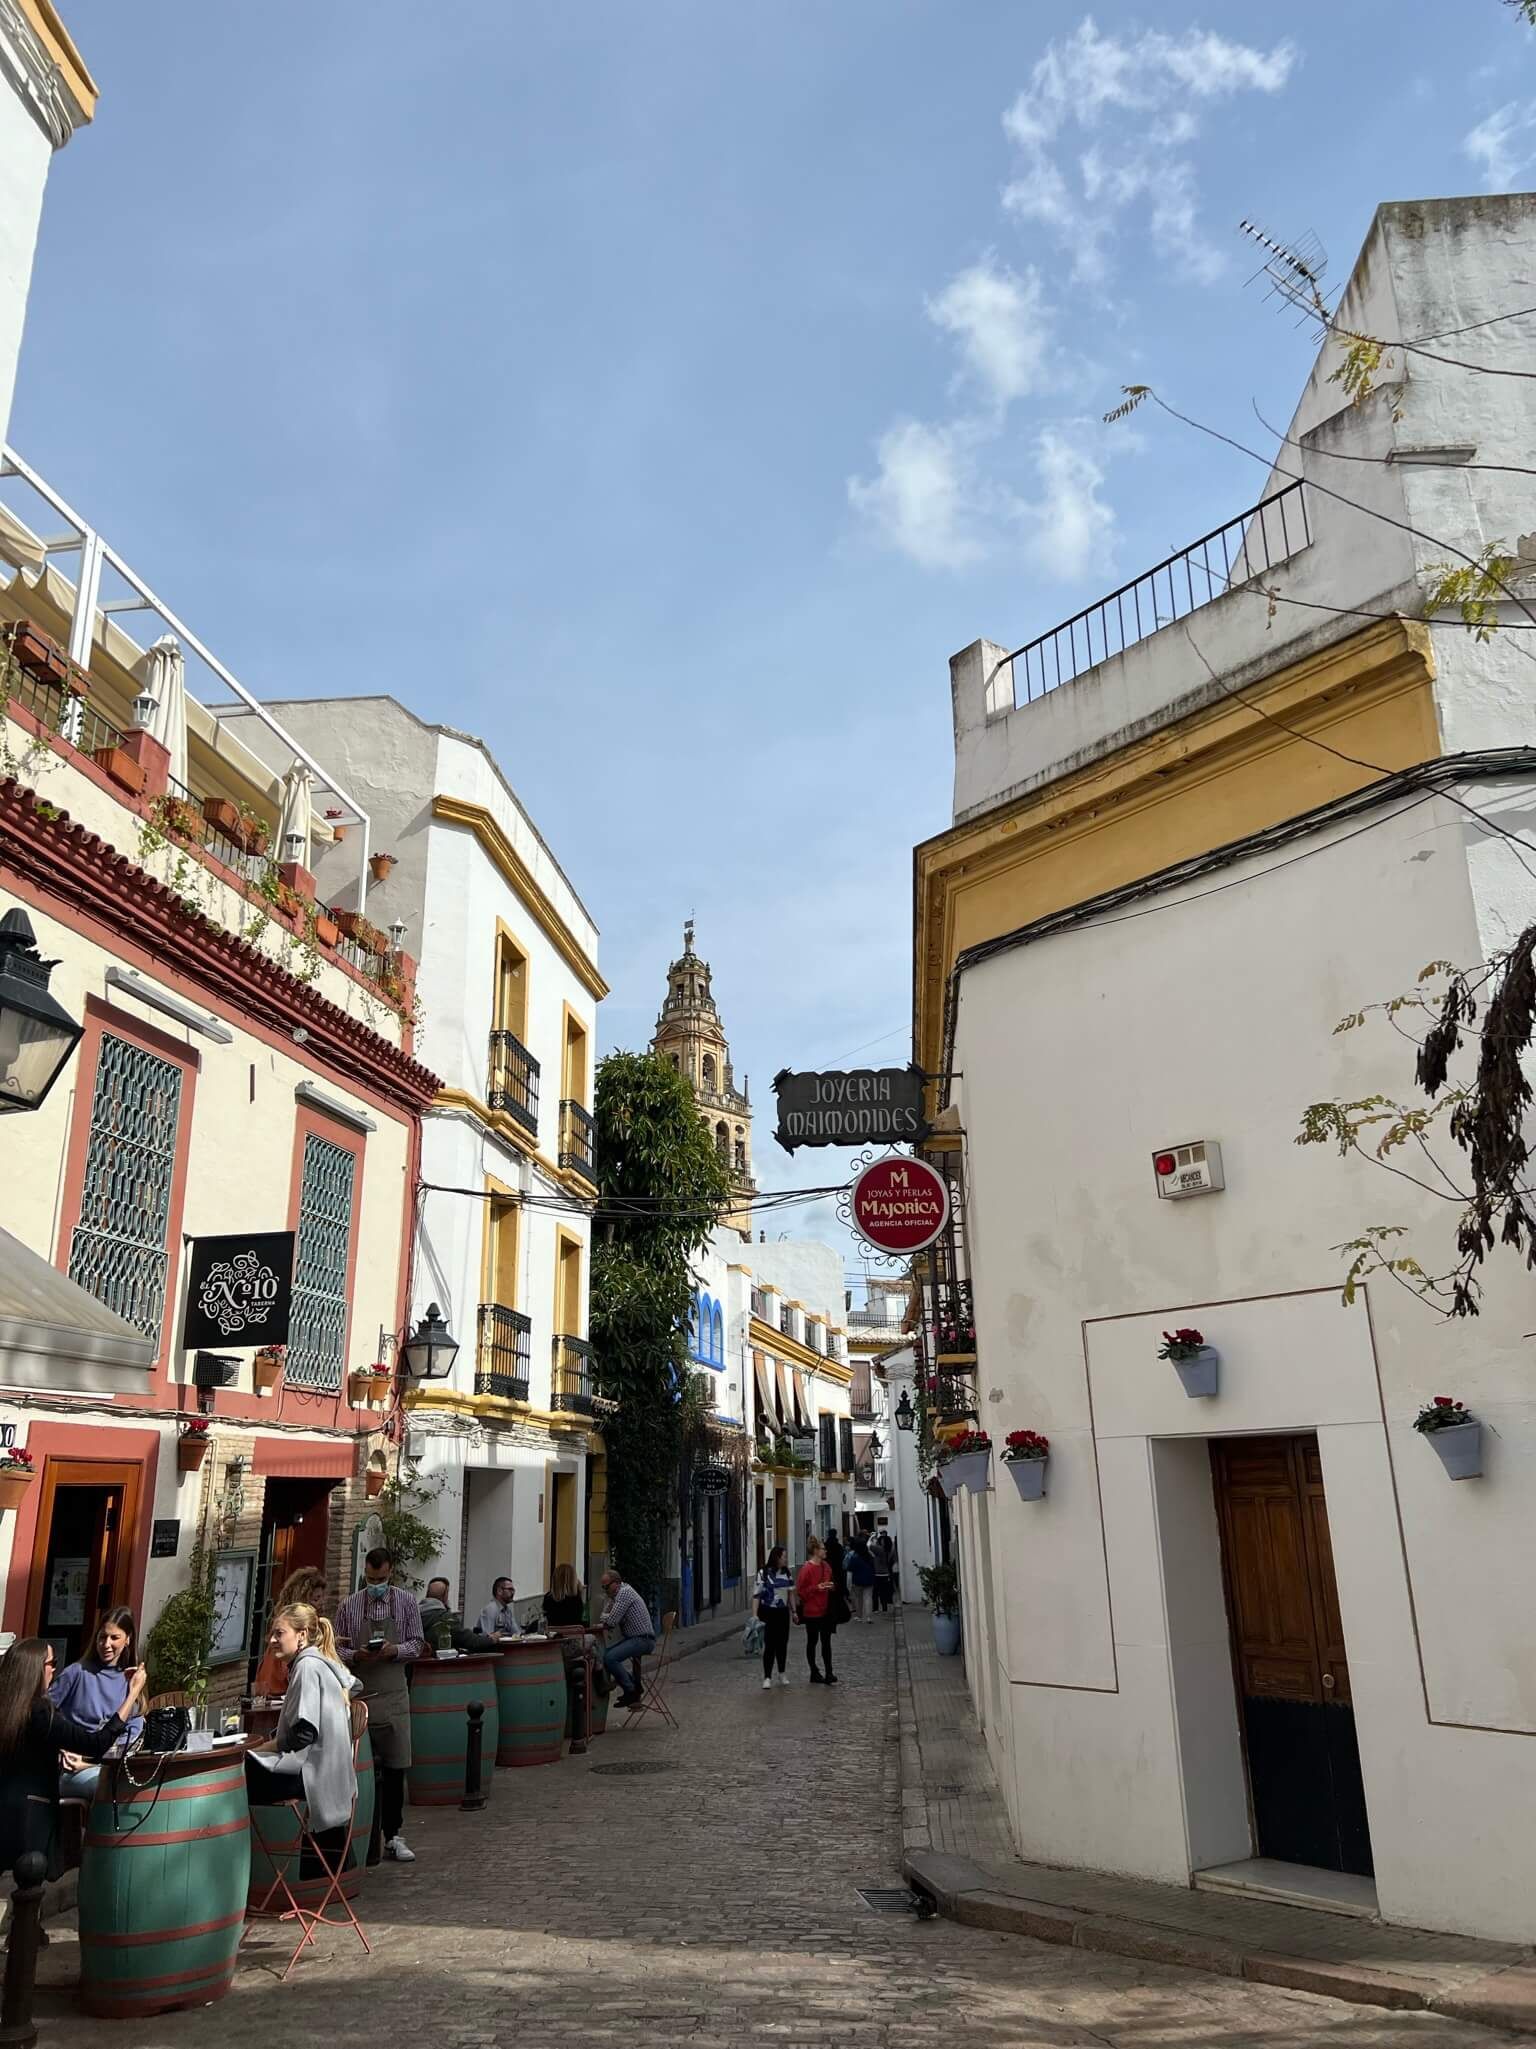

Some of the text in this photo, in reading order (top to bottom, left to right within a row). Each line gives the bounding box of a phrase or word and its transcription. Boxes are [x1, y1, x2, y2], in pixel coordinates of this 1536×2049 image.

[809, 1077, 891, 1104] JOYERIA
[786, 1107, 918, 1136] MAIMONIDES
[867, 1189, 893, 1198] JOYAS
[902, 1188, 933, 1197] PERLAS
[869, 1218, 934, 1227] AGENCIA OFICIAL
